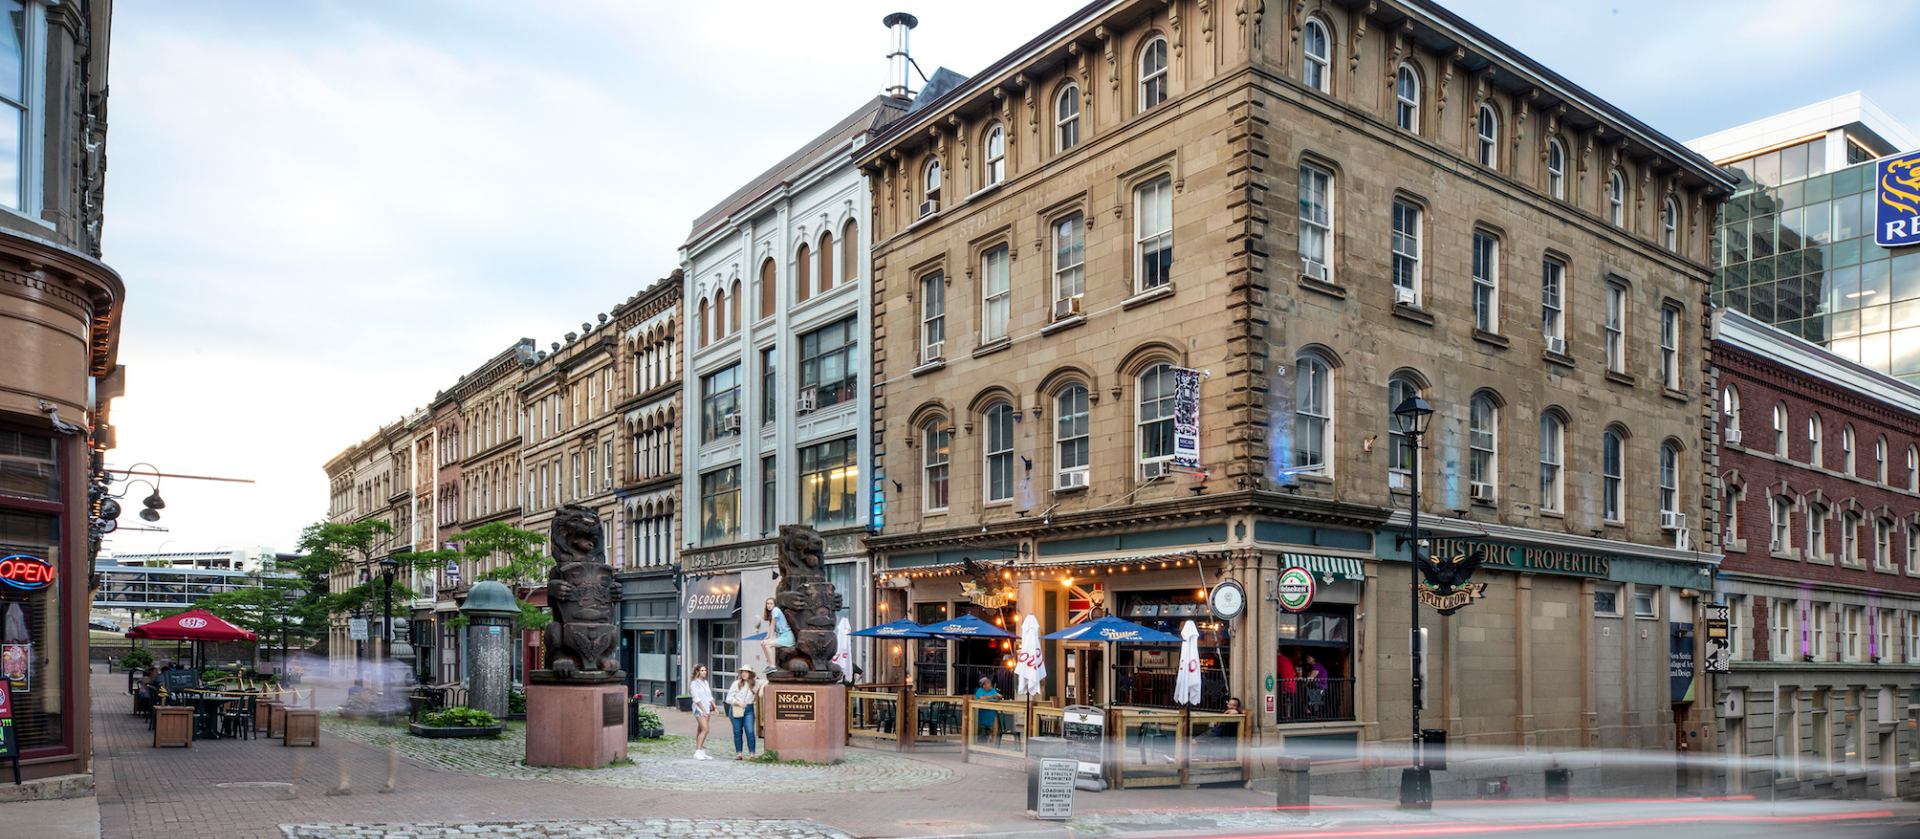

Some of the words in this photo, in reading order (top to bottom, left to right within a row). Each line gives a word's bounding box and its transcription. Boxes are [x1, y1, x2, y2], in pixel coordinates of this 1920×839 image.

[690, 554, 707, 568] 133
[1436, 538, 1517, 566] HISTORIC
[1525, 549, 1609, 575] PROPERTIES
[0, 560, 54, 582] OPEN
[698, 593, 731, 605] COOKED
[973, 593, 989, 607] SPLIT
[1421, 591, 1442, 608] SPLIT
[1443, 592, 1468, 609] CROW
[1099, 630, 1139, 640] Miller
[1144, 657, 1165, 665] CANADIAN
[1679, 651, 1691, 659] Scotia
[1670, 661, 1681, 669] ollege
[1678, 669, 1691, 678] Design
